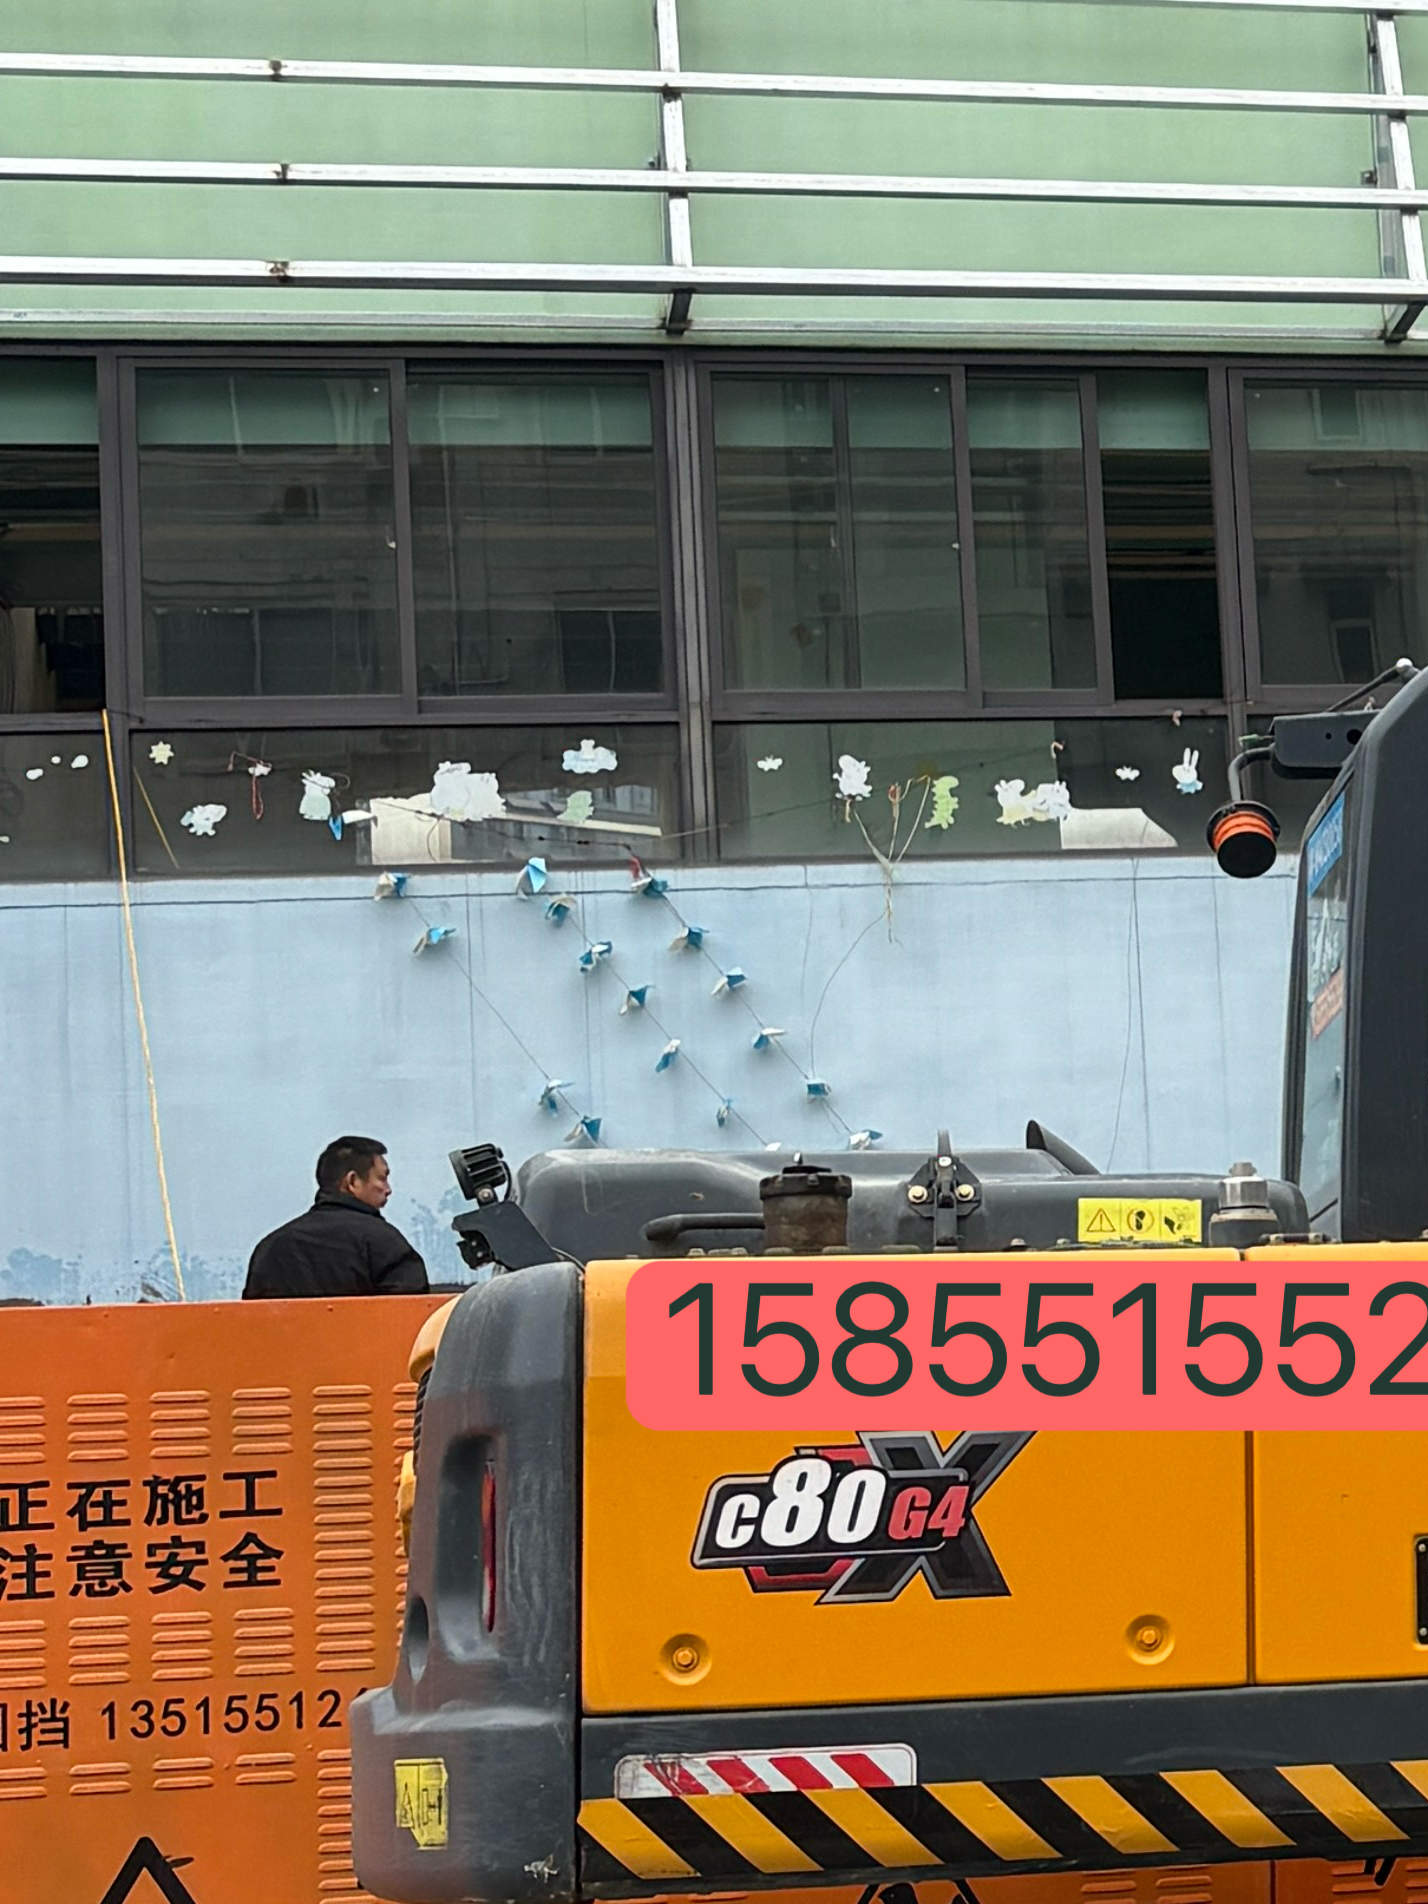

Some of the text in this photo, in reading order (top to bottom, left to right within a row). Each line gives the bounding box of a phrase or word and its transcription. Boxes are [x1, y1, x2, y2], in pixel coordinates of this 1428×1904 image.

[0, 1470, 283, 1532] 正在施工
[0, 1532, 284, 1600] 注意安全
[0, 1686, 372, 1752] 挡 13515512
